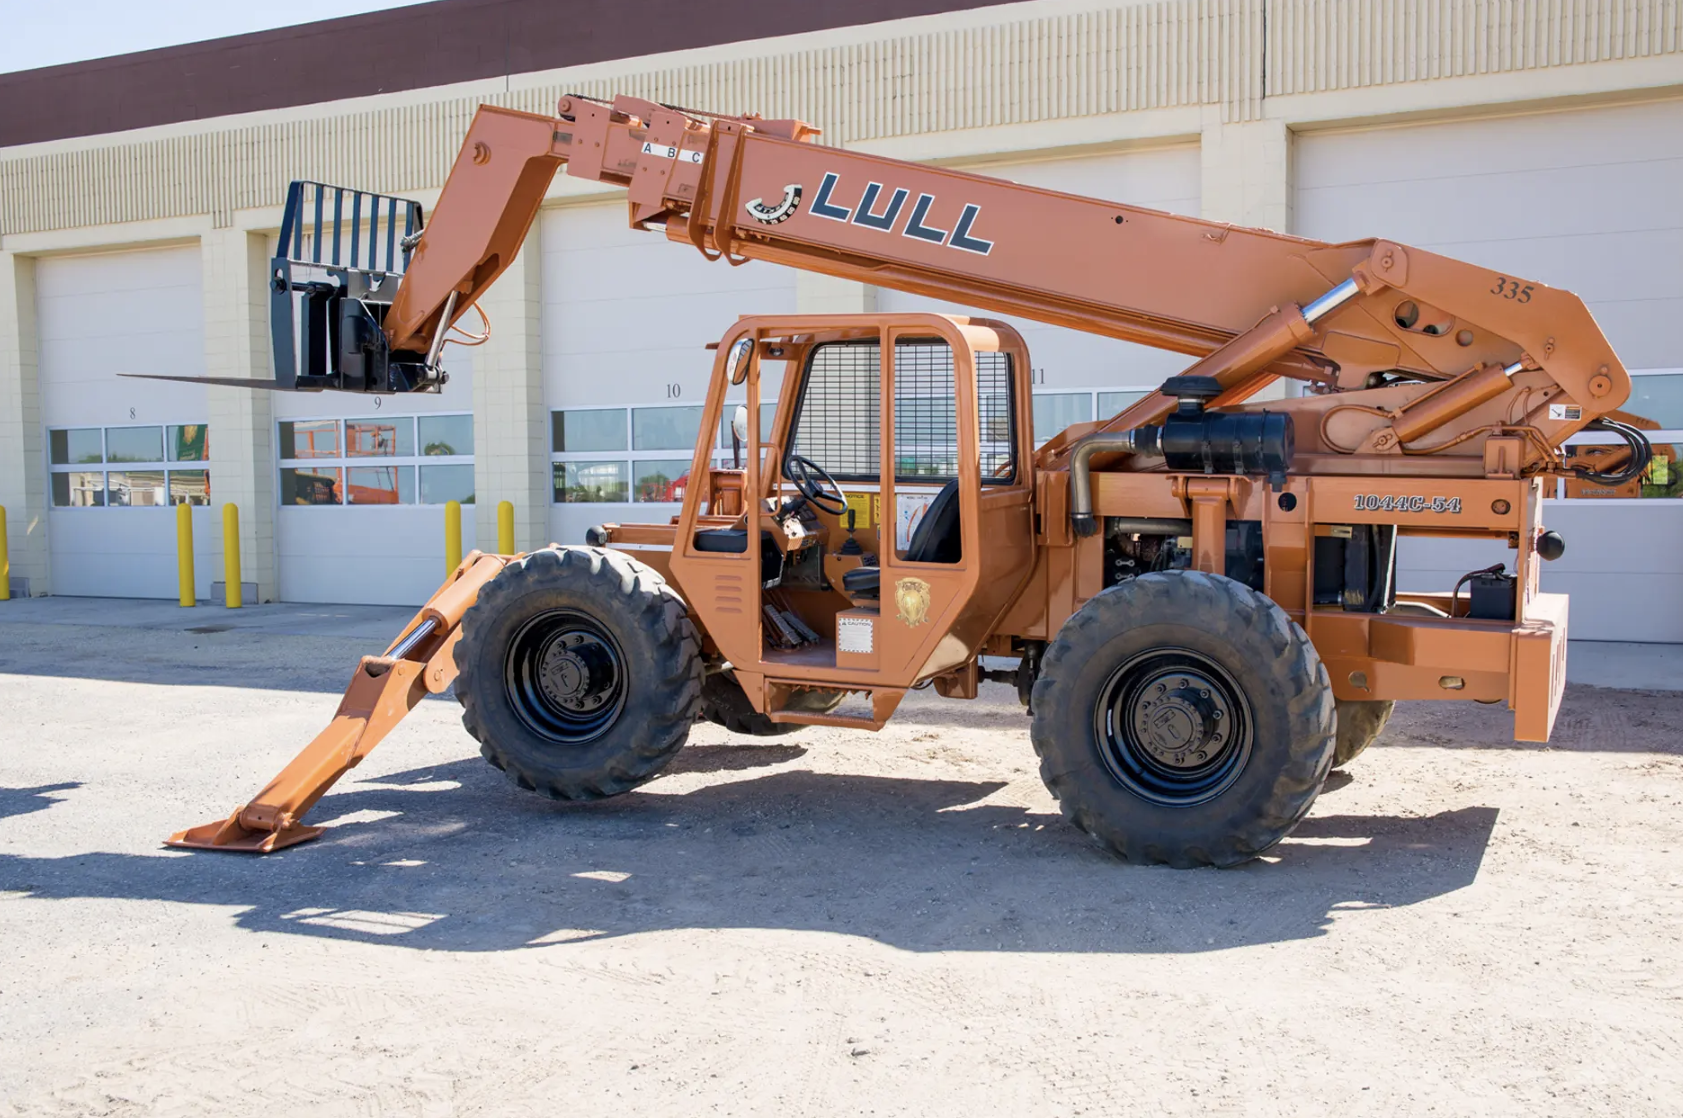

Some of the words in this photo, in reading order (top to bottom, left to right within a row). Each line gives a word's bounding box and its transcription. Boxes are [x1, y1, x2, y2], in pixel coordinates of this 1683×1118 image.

[643, 143, 652, 153] A
[667, 147, 676, 158] B
[691, 152, 700, 163] C
[808, 171, 994, 256] LULL
[1490, 276, 1535, 304] 335
[1031, 368, 1046, 385] 11
[666, 383, 681, 398] 10
[374, 396, 382, 410] 9
[129, 406, 136, 420] 8
[1354, 493, 1463, 514] 1044C-54
